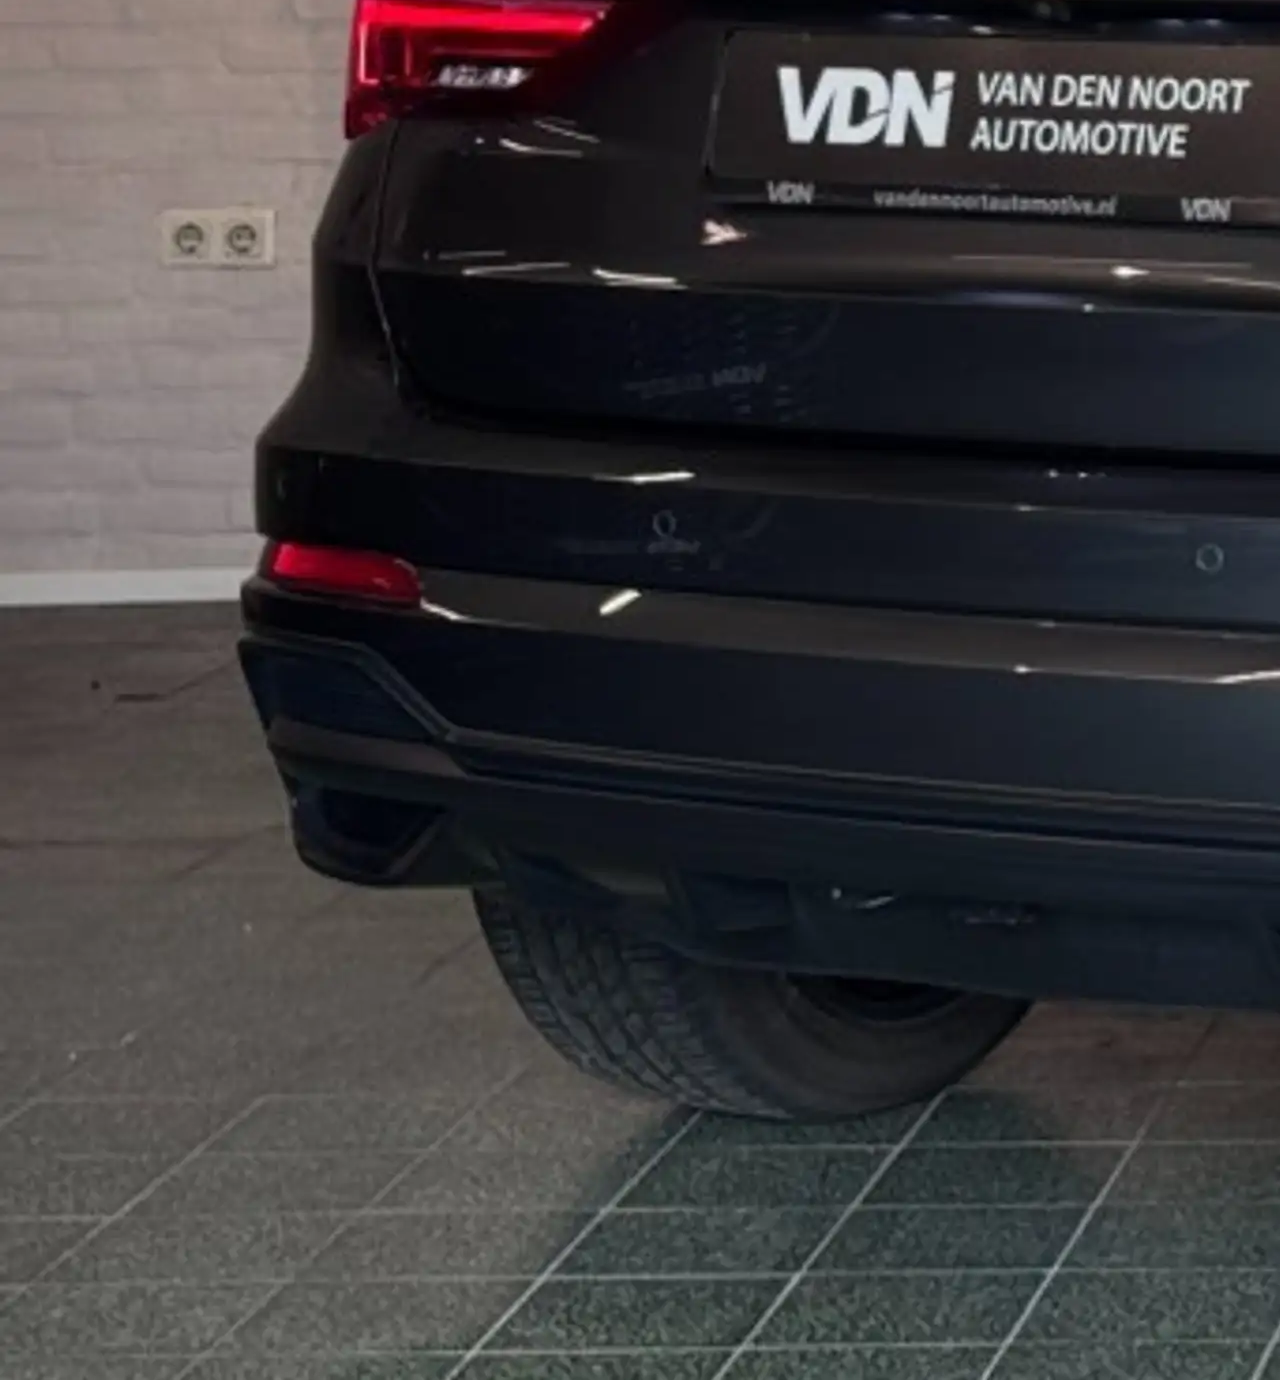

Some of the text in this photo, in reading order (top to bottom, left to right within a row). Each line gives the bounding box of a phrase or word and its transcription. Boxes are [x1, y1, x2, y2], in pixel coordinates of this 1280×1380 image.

[776, 65, 956, 149] VDN
[977, 71, 1253, 114] VAN DEN NOORT
[969, 116, 1191, 159] AUTOMOTIVE
[766, 180, 816, 205] VDN
[873, 188, 1118, 217] vandennoortautomotive.nl
[1180, 197, 1232, 223] VDN
